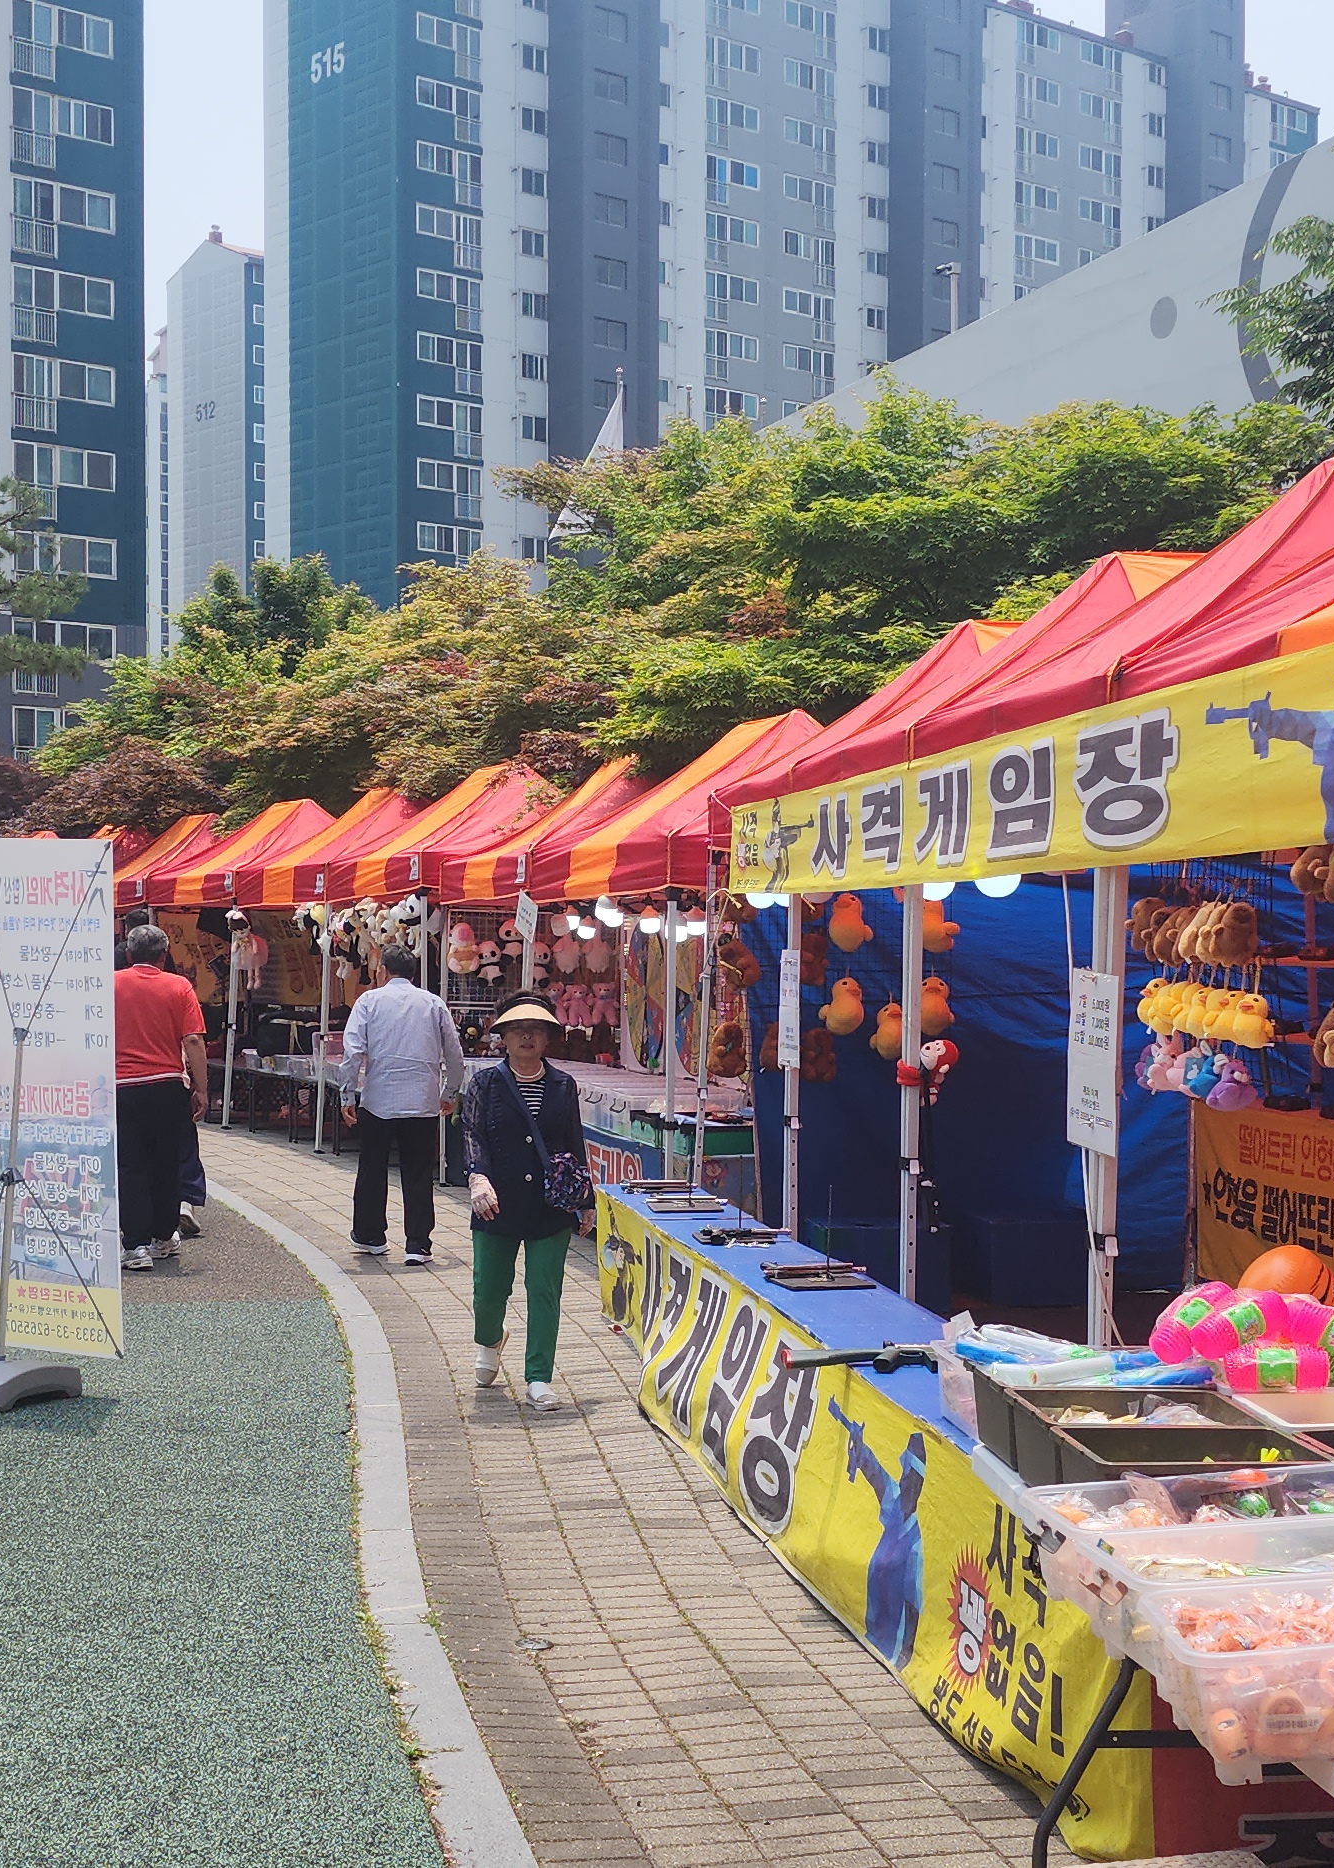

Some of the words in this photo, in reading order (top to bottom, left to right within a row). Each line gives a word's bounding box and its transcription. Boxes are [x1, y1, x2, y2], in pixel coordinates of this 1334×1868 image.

[310, 41, 345, 84] 515
[196, 400, 216, 422] 512
[811, 706, 1176, 878] 사격게임장
[1239, 1123, 1296, 1175] 떨어트린
[1213, 1167, 1259, 1236] 인형을
[640, 1232, 819, 1535] 사격게임장
[957, 1578, 1065, 1759] 꽝없음!
